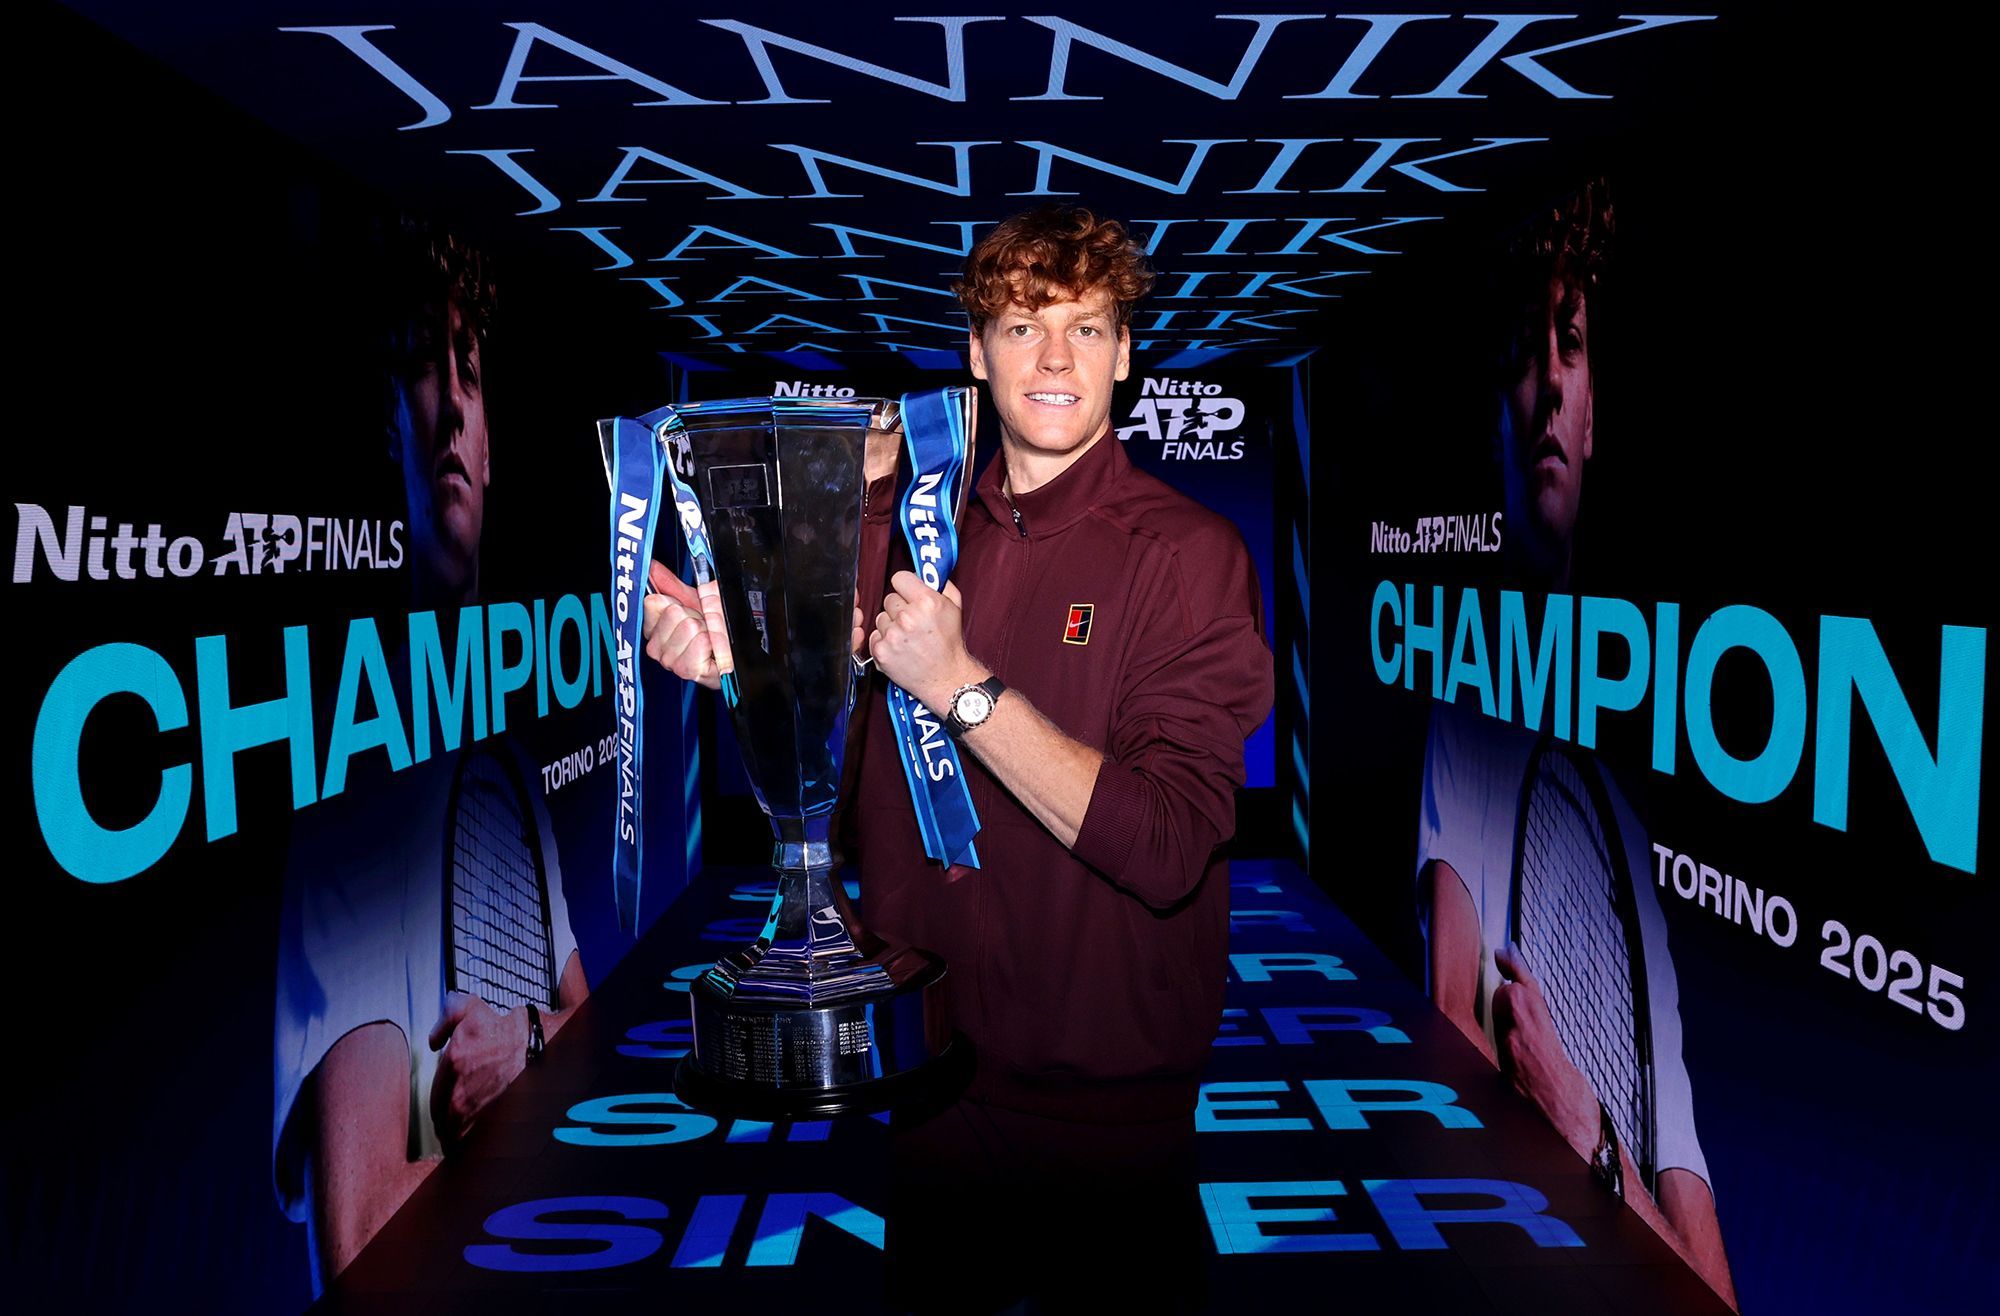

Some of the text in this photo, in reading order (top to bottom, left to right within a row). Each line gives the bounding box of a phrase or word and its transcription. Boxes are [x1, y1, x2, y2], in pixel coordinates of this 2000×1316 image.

[278, 14, 1718, 131] JANNIK
[445, 138, 1549, 215] JANNIK
[619, 271, 1372, 309] JANIK
[669, 309, 1318, 338] JANIK
[773, 381, 855, 397] Nitto
[1141, 377, 1222, 396] Nitto
[1114, 397, 1245, 440] ATP
[1162, 441, 1245, 460] FINALS
[13, 503, 404, 583] Nitto ATP FINALS
[909, 470, 944, 592] Nitto
[1371, 512, 1502, 553] Nitto ATP FINALS
[616, 492, 648, 845] Nitto ATP FINALS
[1371, 580, 1987, 875] CHAMPION
[542, 732, 618, 795] TORINO 202
[1653, 842, 1966, 1031] TORINO 2025
